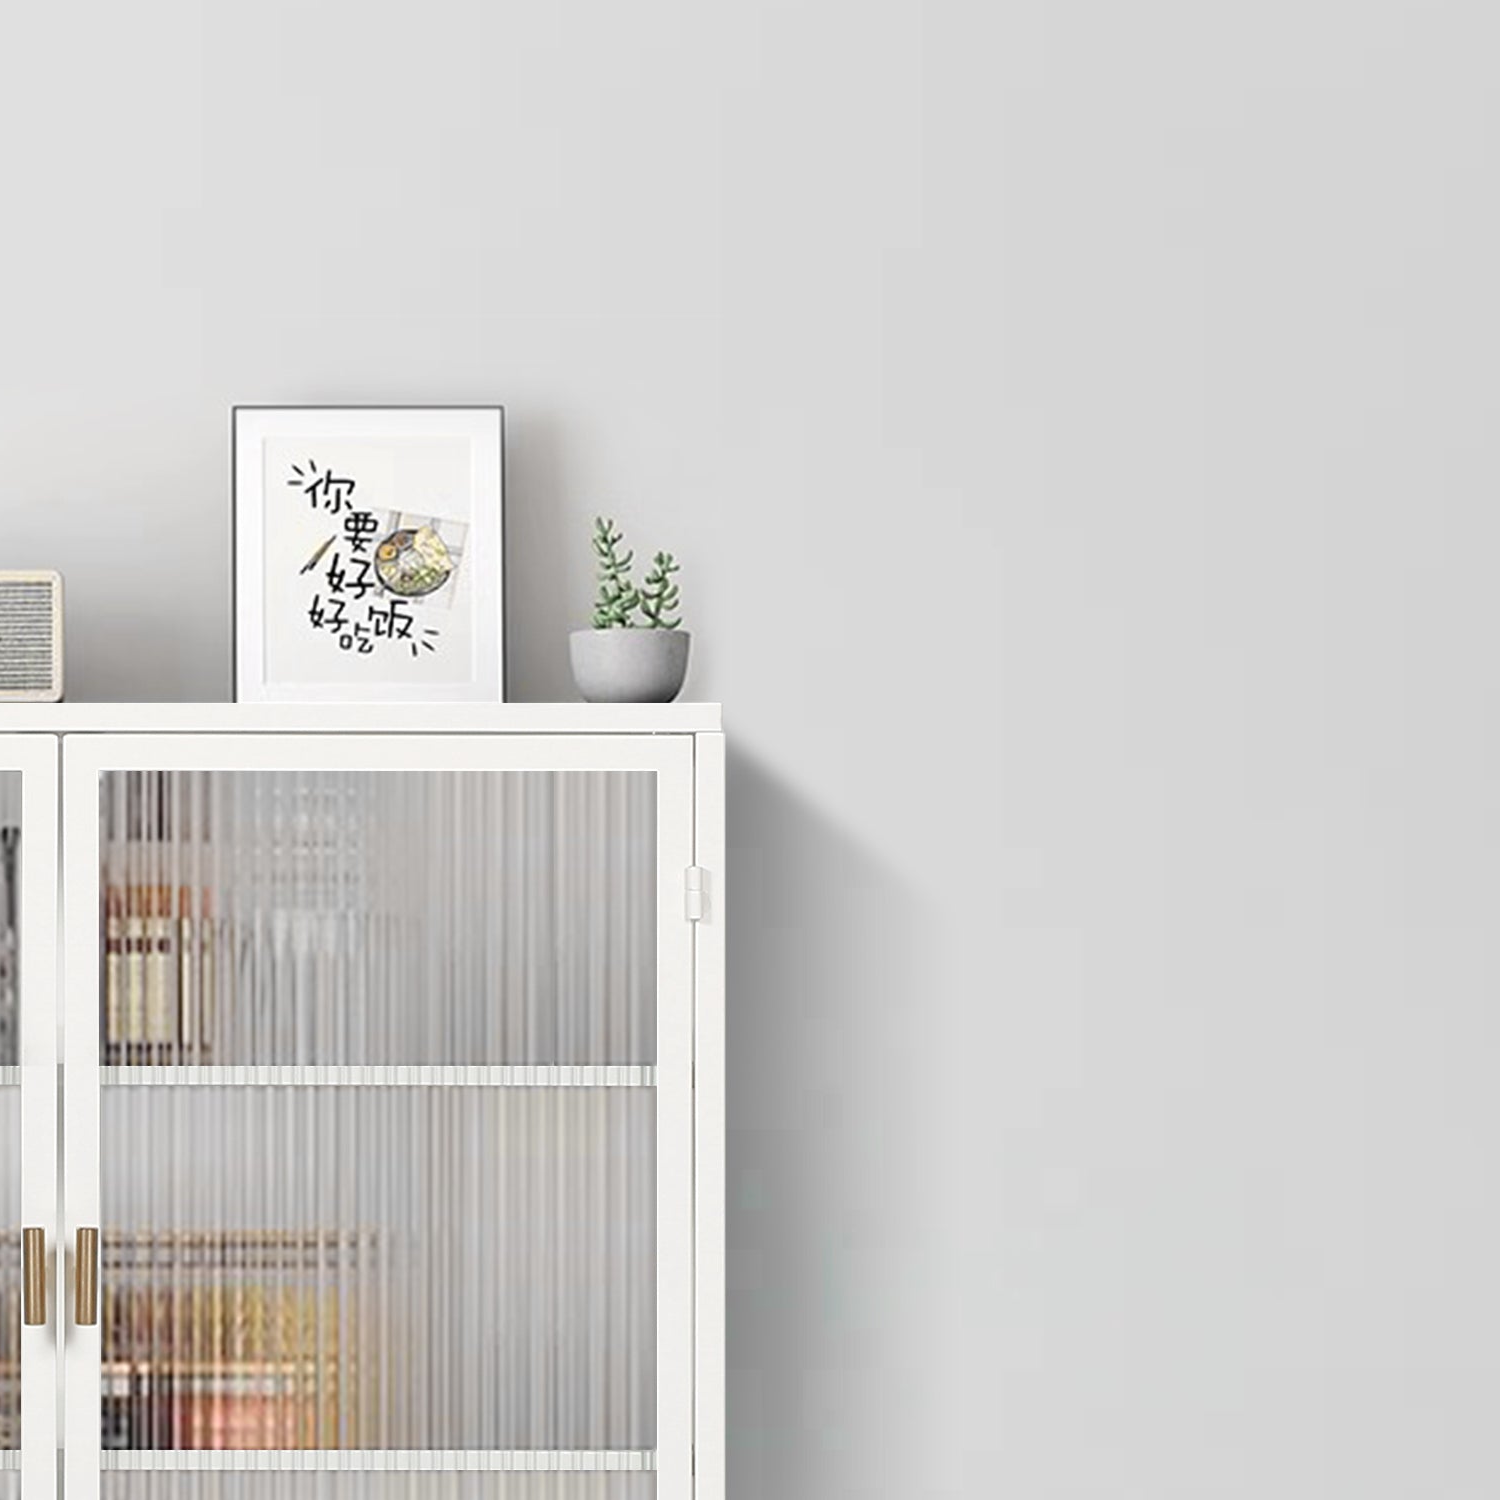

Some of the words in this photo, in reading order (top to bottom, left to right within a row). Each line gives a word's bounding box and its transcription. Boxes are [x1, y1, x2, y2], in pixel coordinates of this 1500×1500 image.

[305, 470, 355, 513] 你
[344, 512, 378, 552] 要
[326, 553, 375, 599] 好
